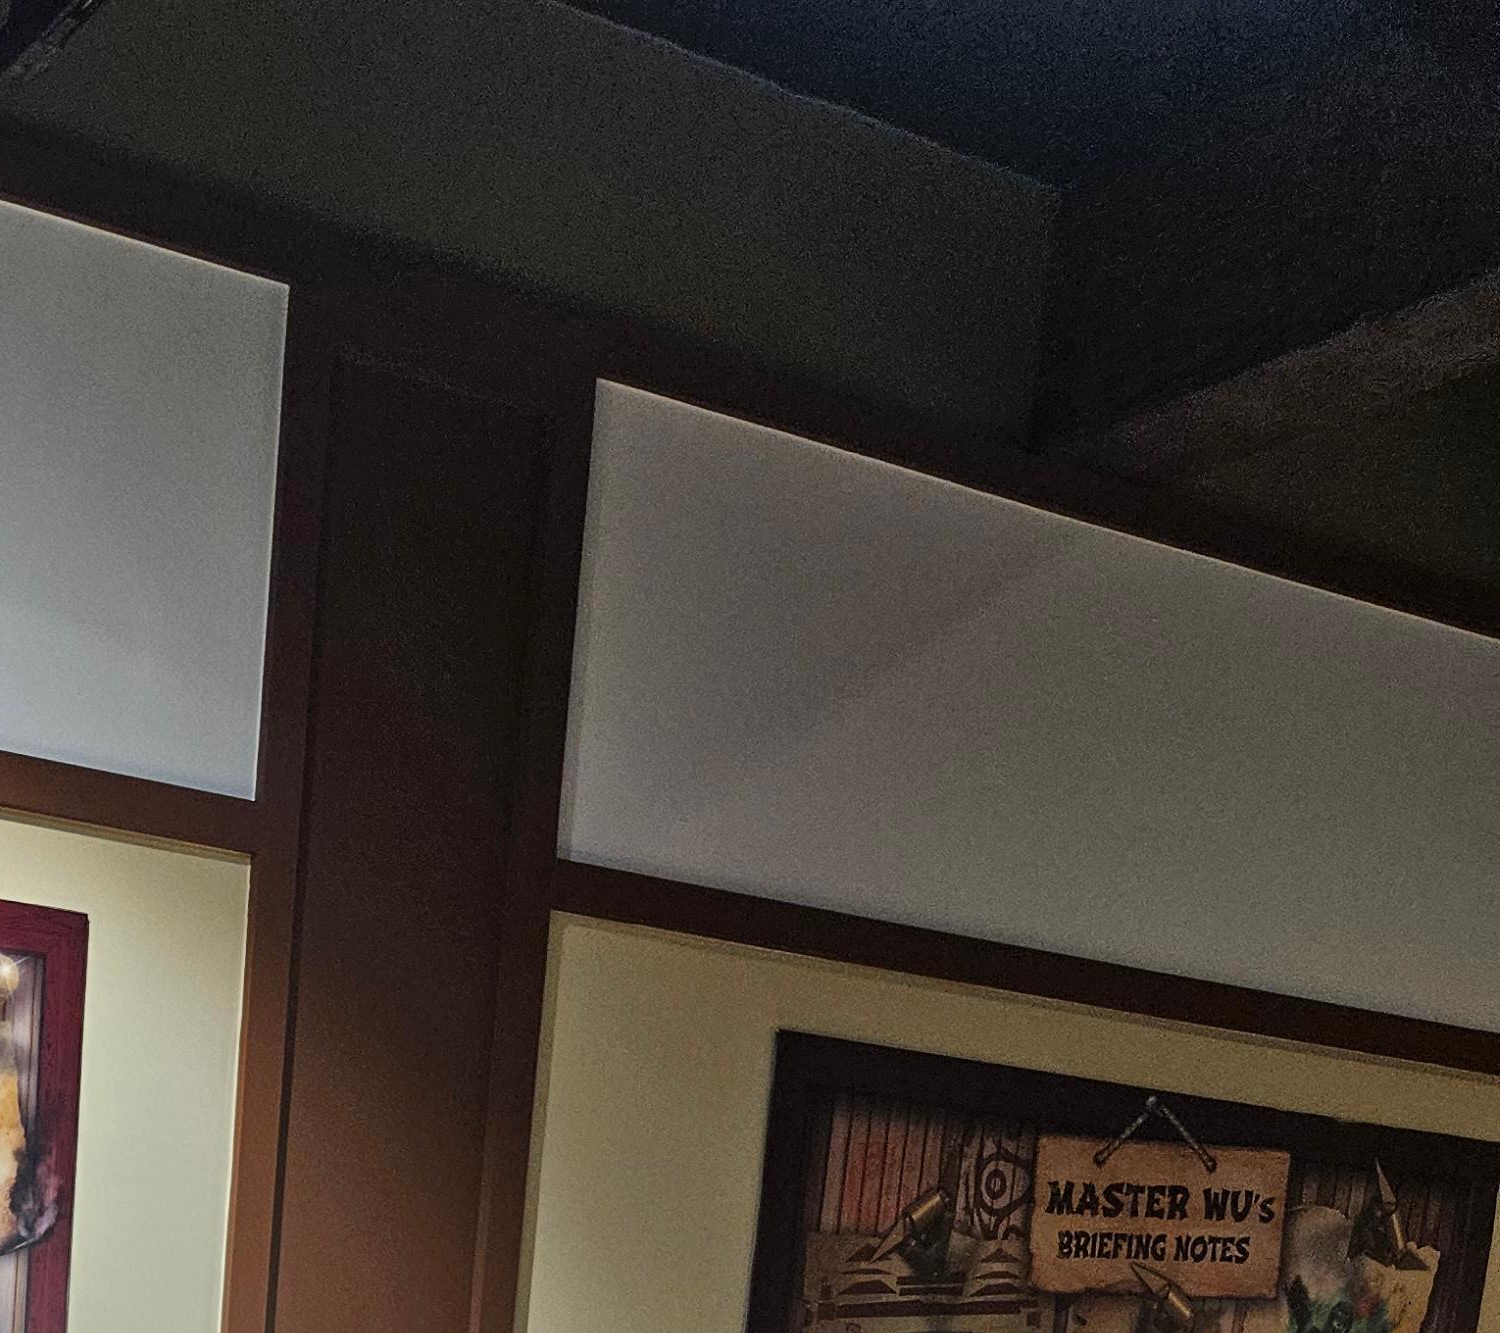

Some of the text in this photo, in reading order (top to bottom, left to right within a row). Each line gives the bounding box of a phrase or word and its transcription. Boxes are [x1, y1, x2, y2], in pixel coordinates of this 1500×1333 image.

[1045, 1180, 1190, 1221] MASTER
[1057, 1230, 1250, 1264] BRIEFING NOTES
